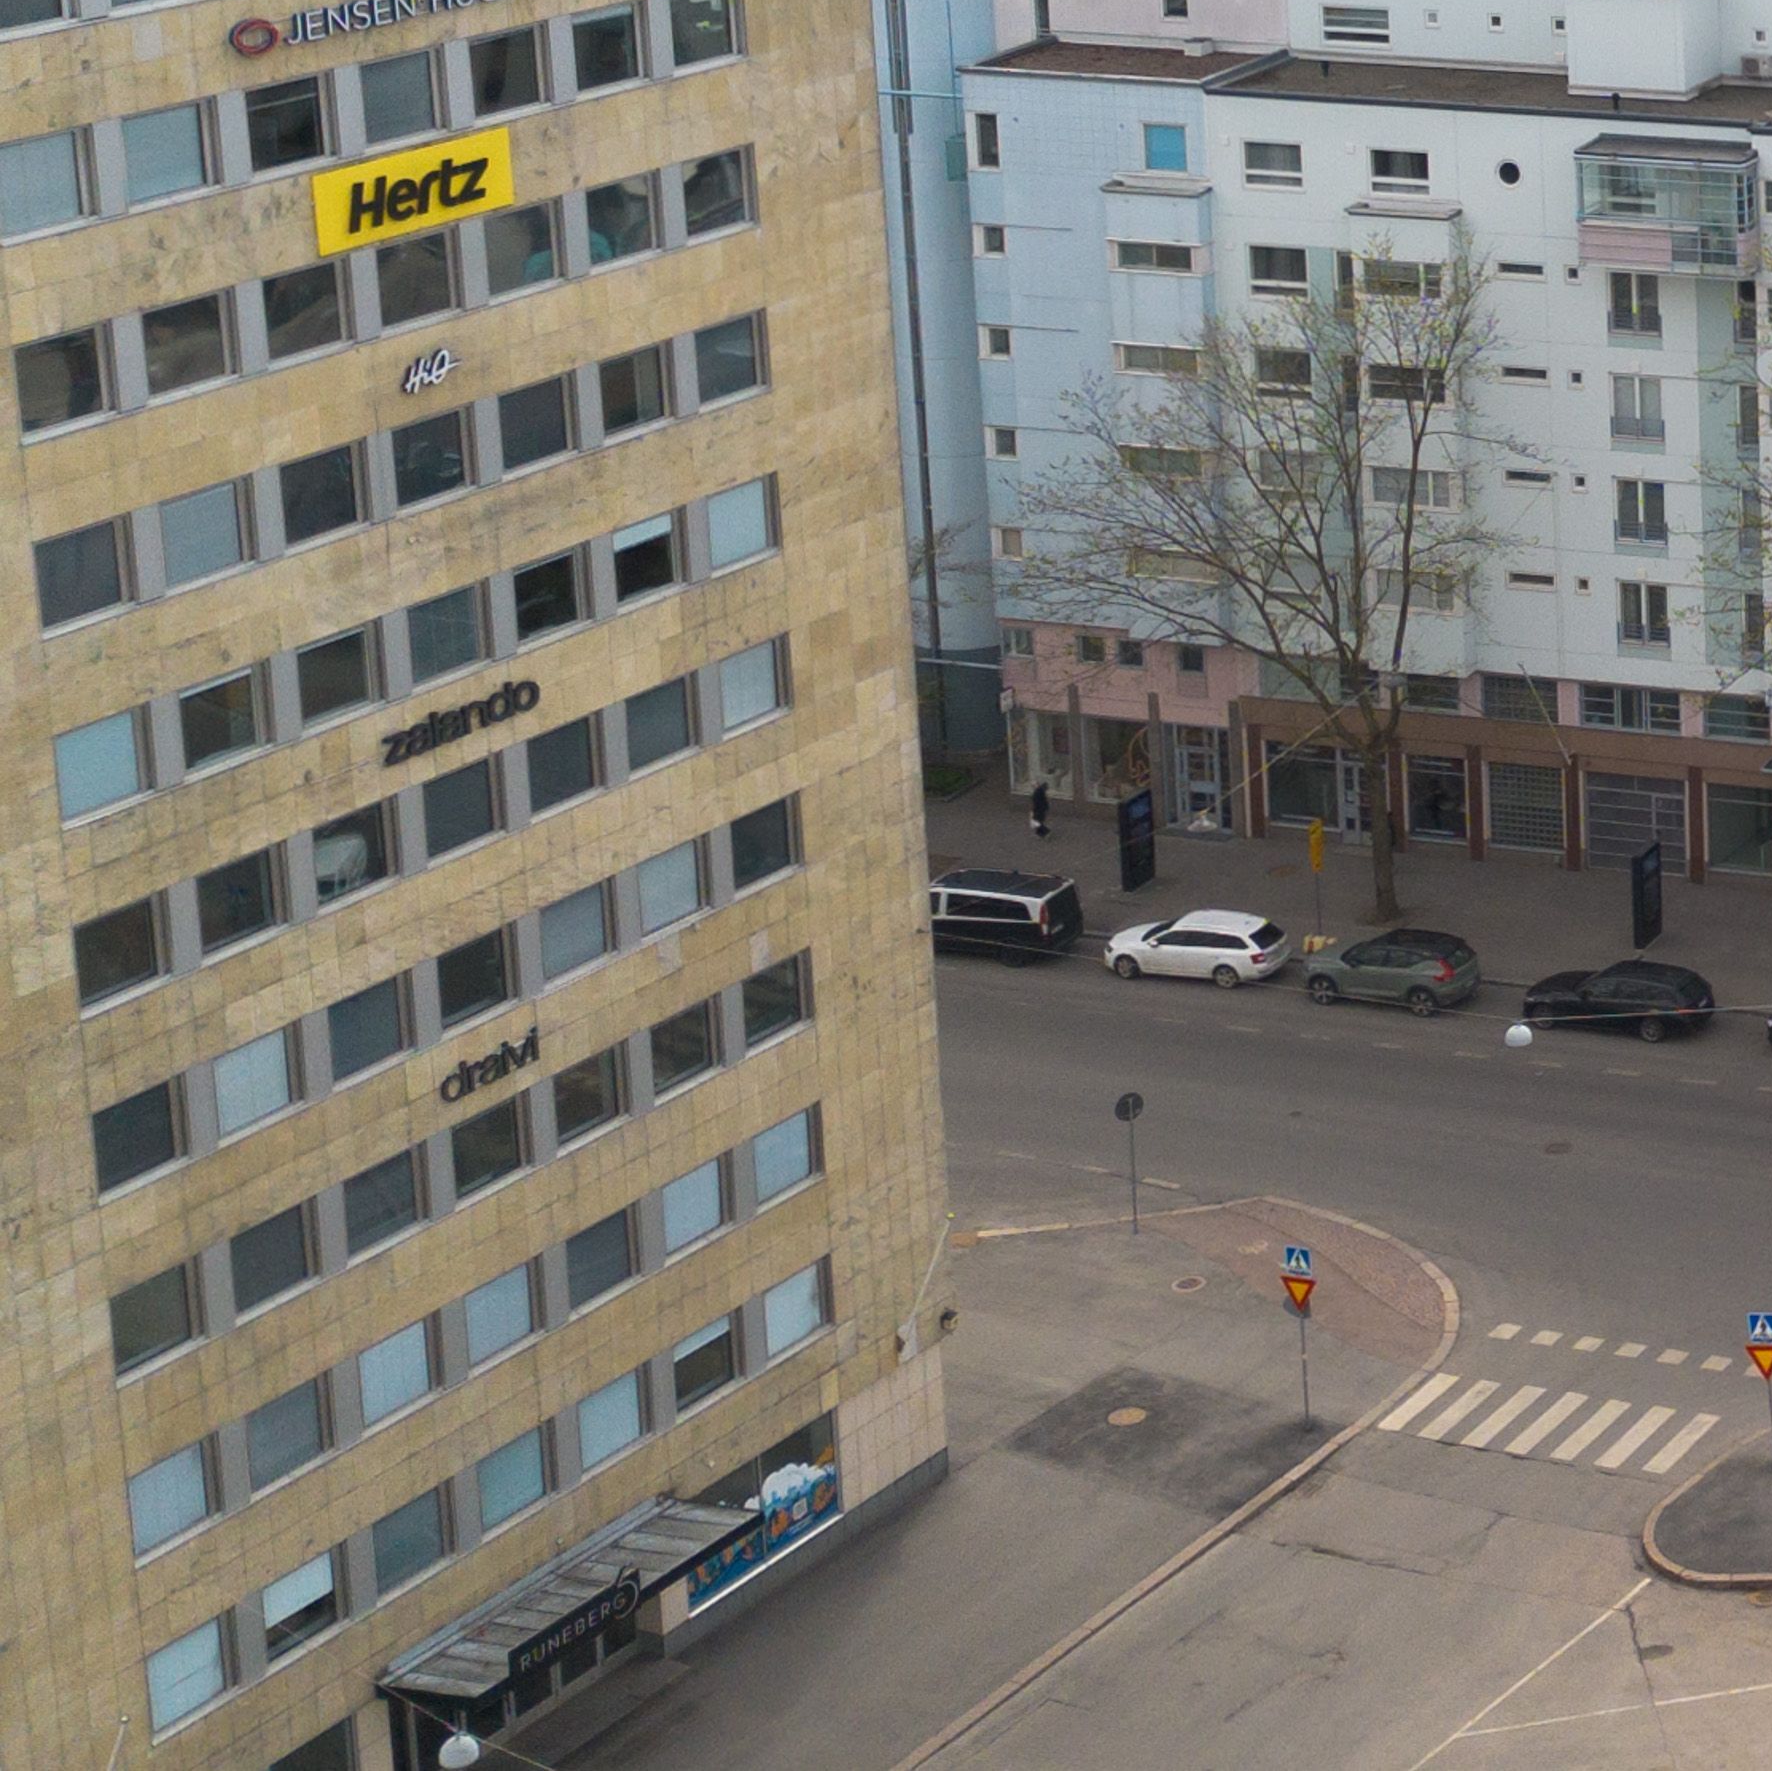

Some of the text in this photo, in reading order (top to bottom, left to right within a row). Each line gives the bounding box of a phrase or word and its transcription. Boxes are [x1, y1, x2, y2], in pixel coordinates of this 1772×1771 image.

[349, 157, 489, 234] Hertz
[382, 681, 540, 766] zalando
[441, 1025, 539, 1103] draivi
